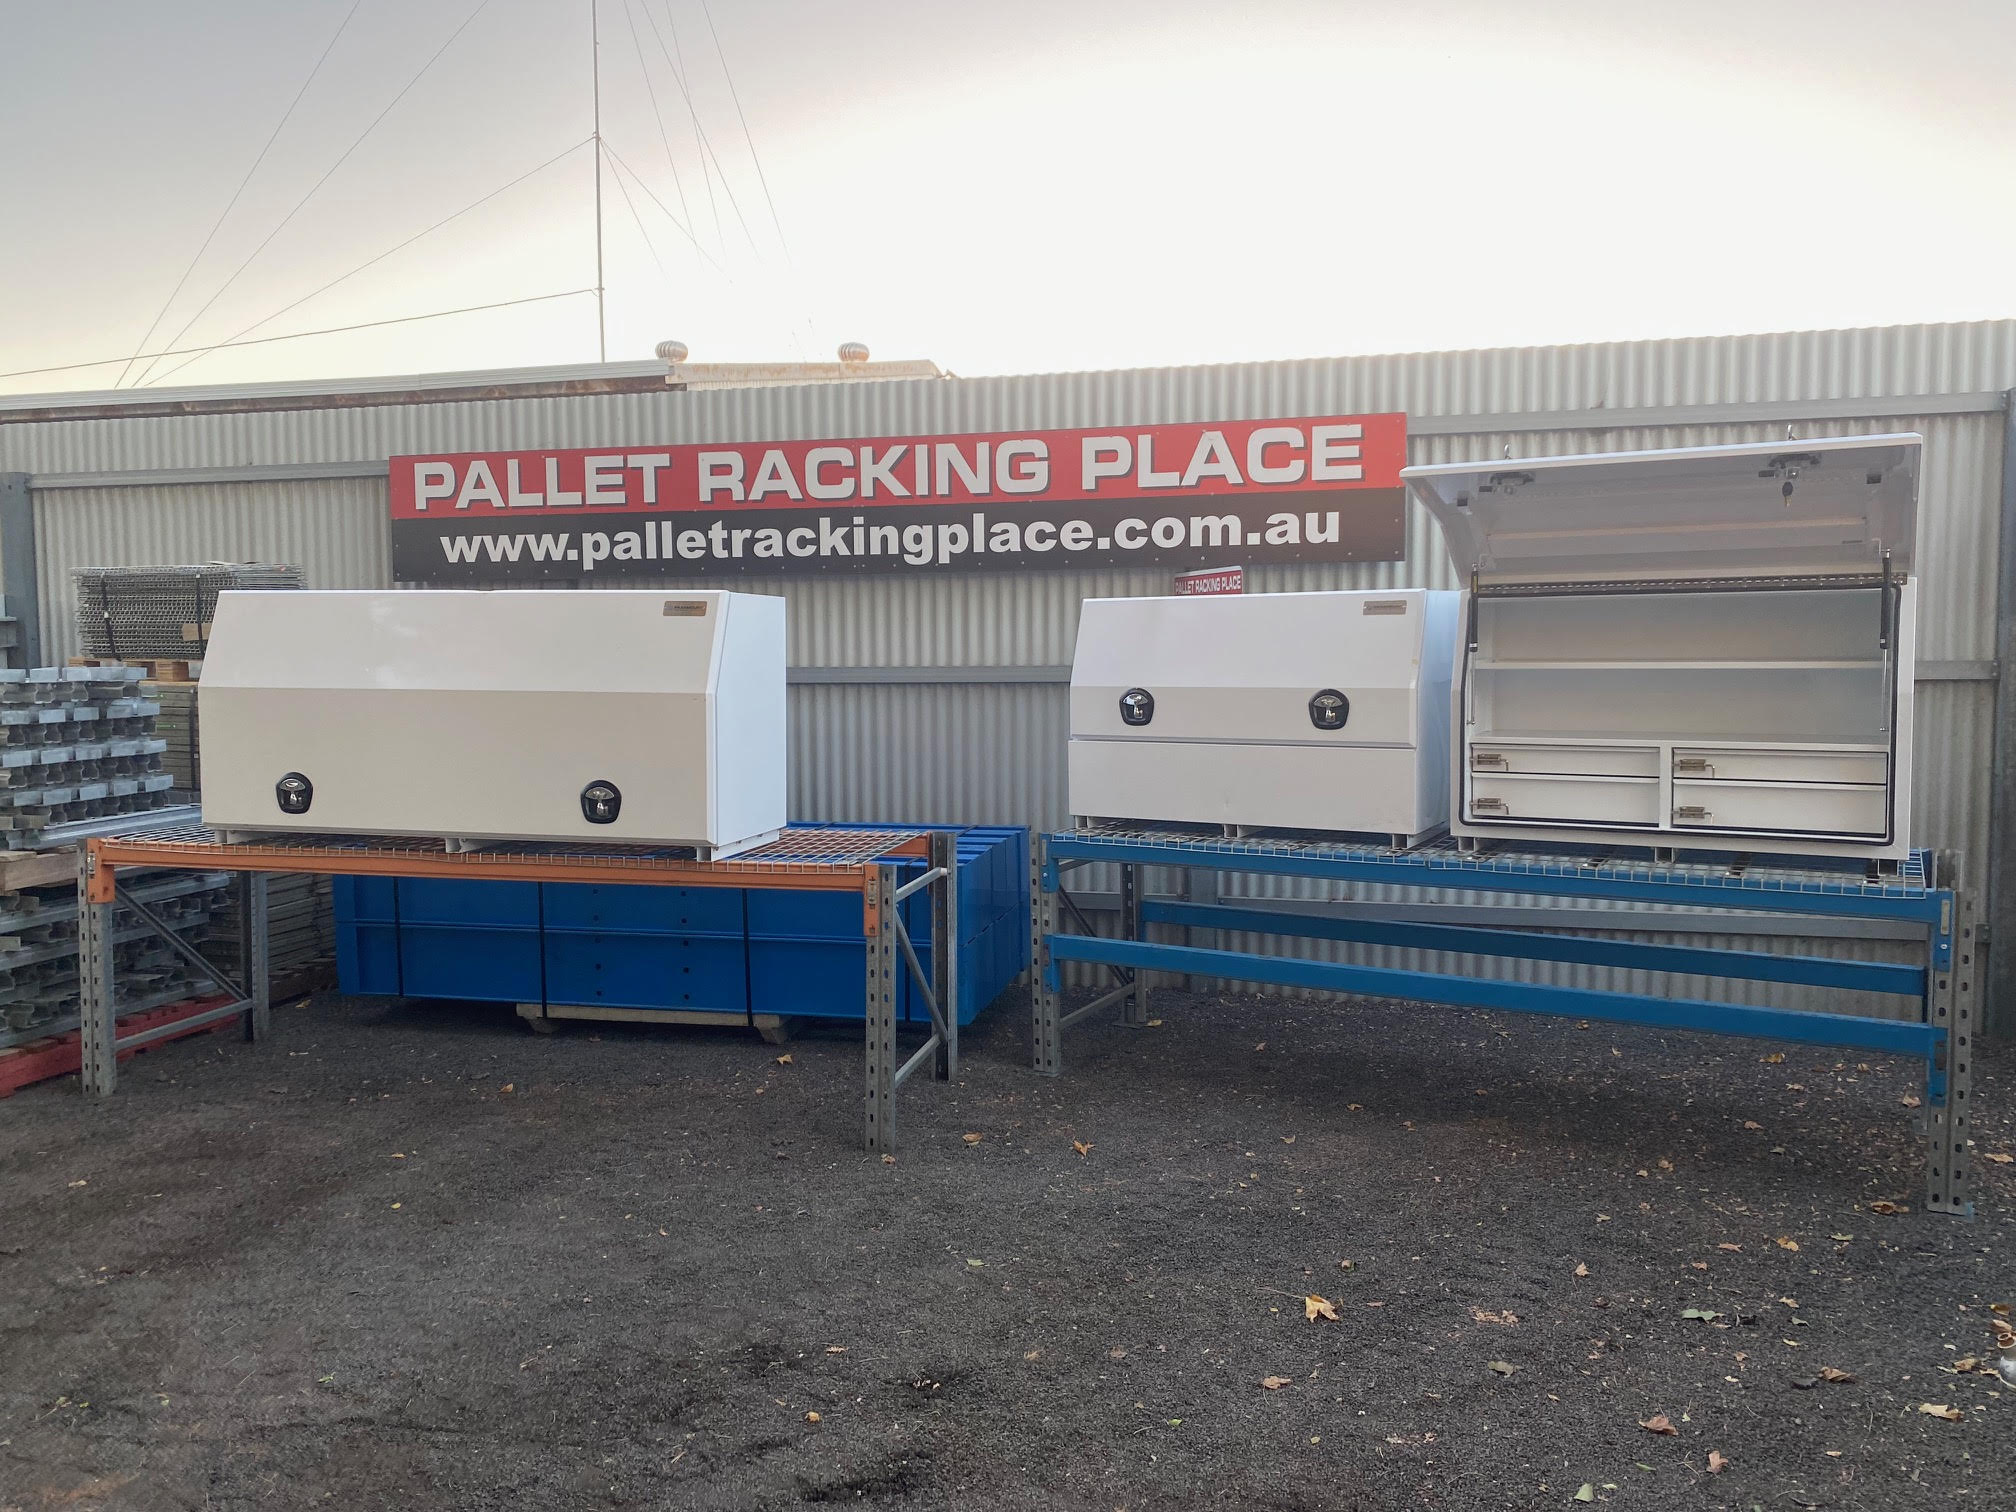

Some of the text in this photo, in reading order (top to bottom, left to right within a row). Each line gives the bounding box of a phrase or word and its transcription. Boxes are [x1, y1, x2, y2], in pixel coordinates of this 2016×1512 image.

[413, 423, 1364, 511] PALLET RACKING PLACE
[439, 511, 1341, 571] www.palletrackingplace.com.au
[1195, 578, 1221, 593] RACKING
[1221, 575, 1241, 590] PLACE
